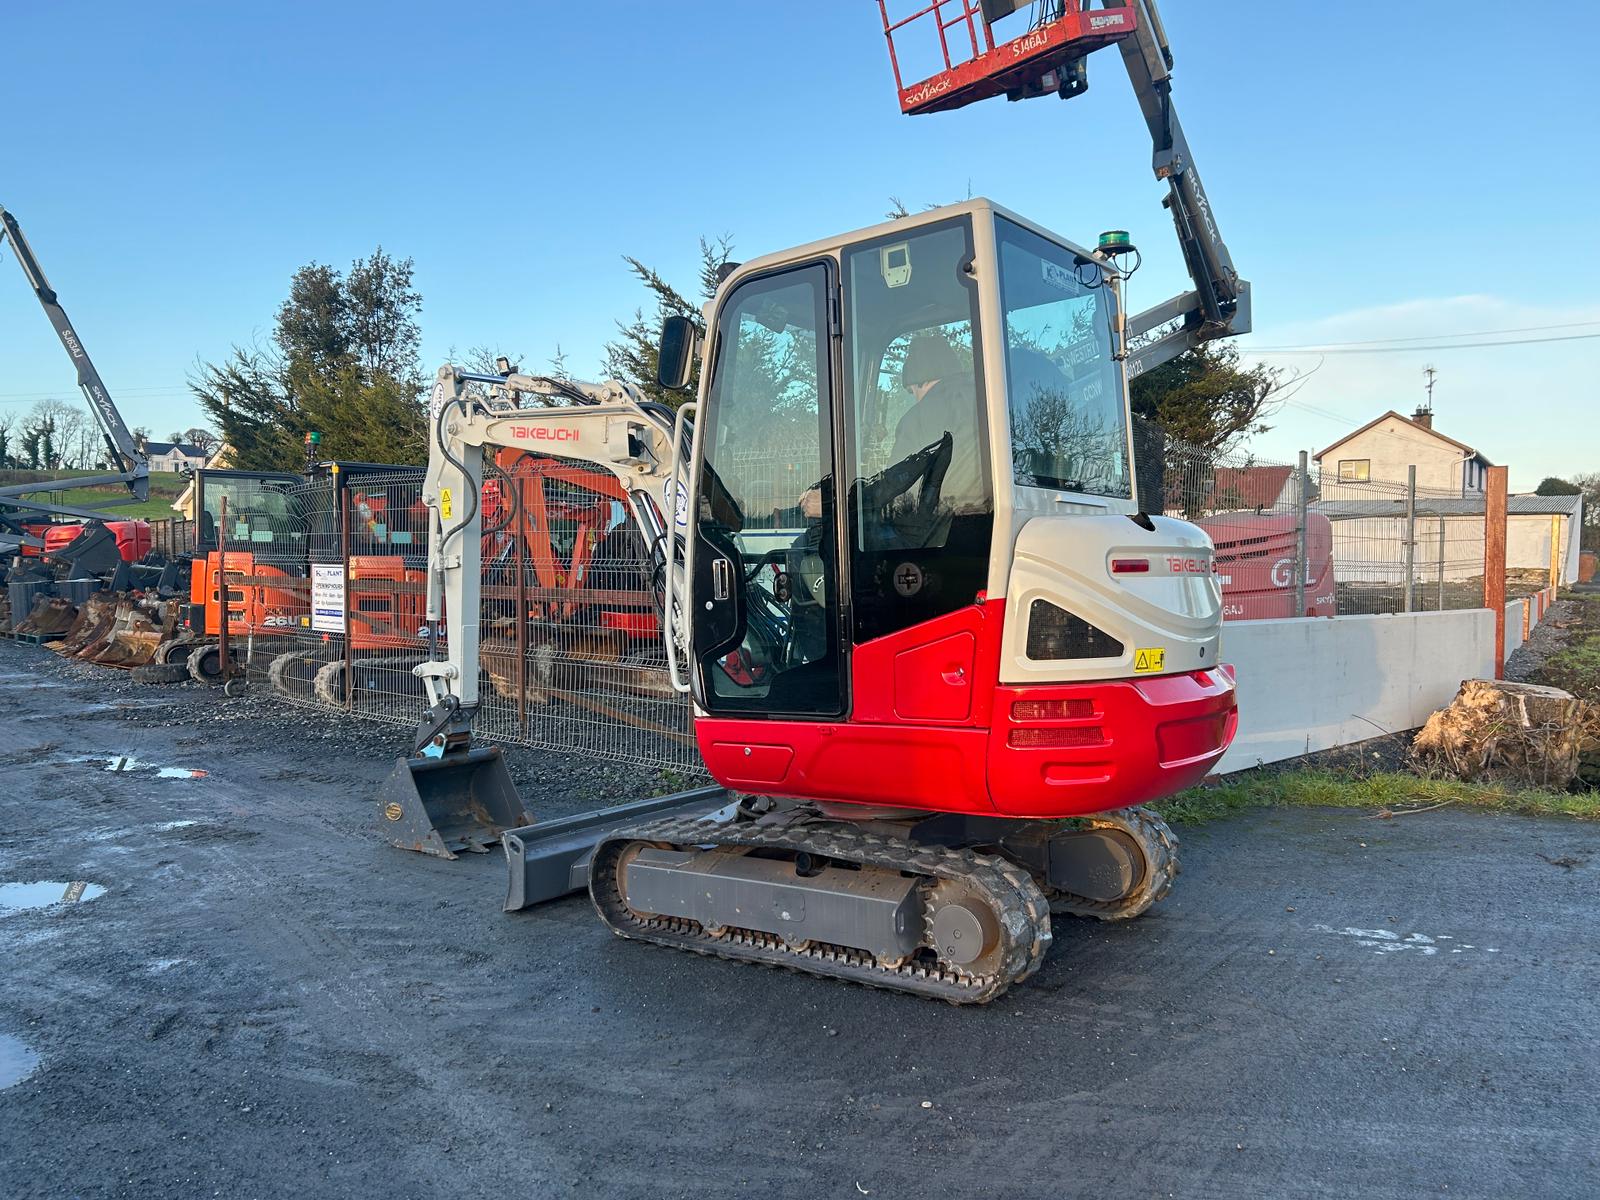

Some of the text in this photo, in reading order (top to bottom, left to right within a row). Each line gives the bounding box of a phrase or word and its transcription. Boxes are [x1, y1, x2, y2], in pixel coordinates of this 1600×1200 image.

[1013, 31, 1047, 57] SJ46AJ
[904, 78, 952, 105] SKYJACK
[1187, 167, 1216, 243] SKYJACK
[62, 329, 83, 358] SJ63AJ
[92, 385, 118, 428] SKYJACK
[510, 426, 580, 442] TAKEUCHI
[417, 625, 446, 638] 2U
